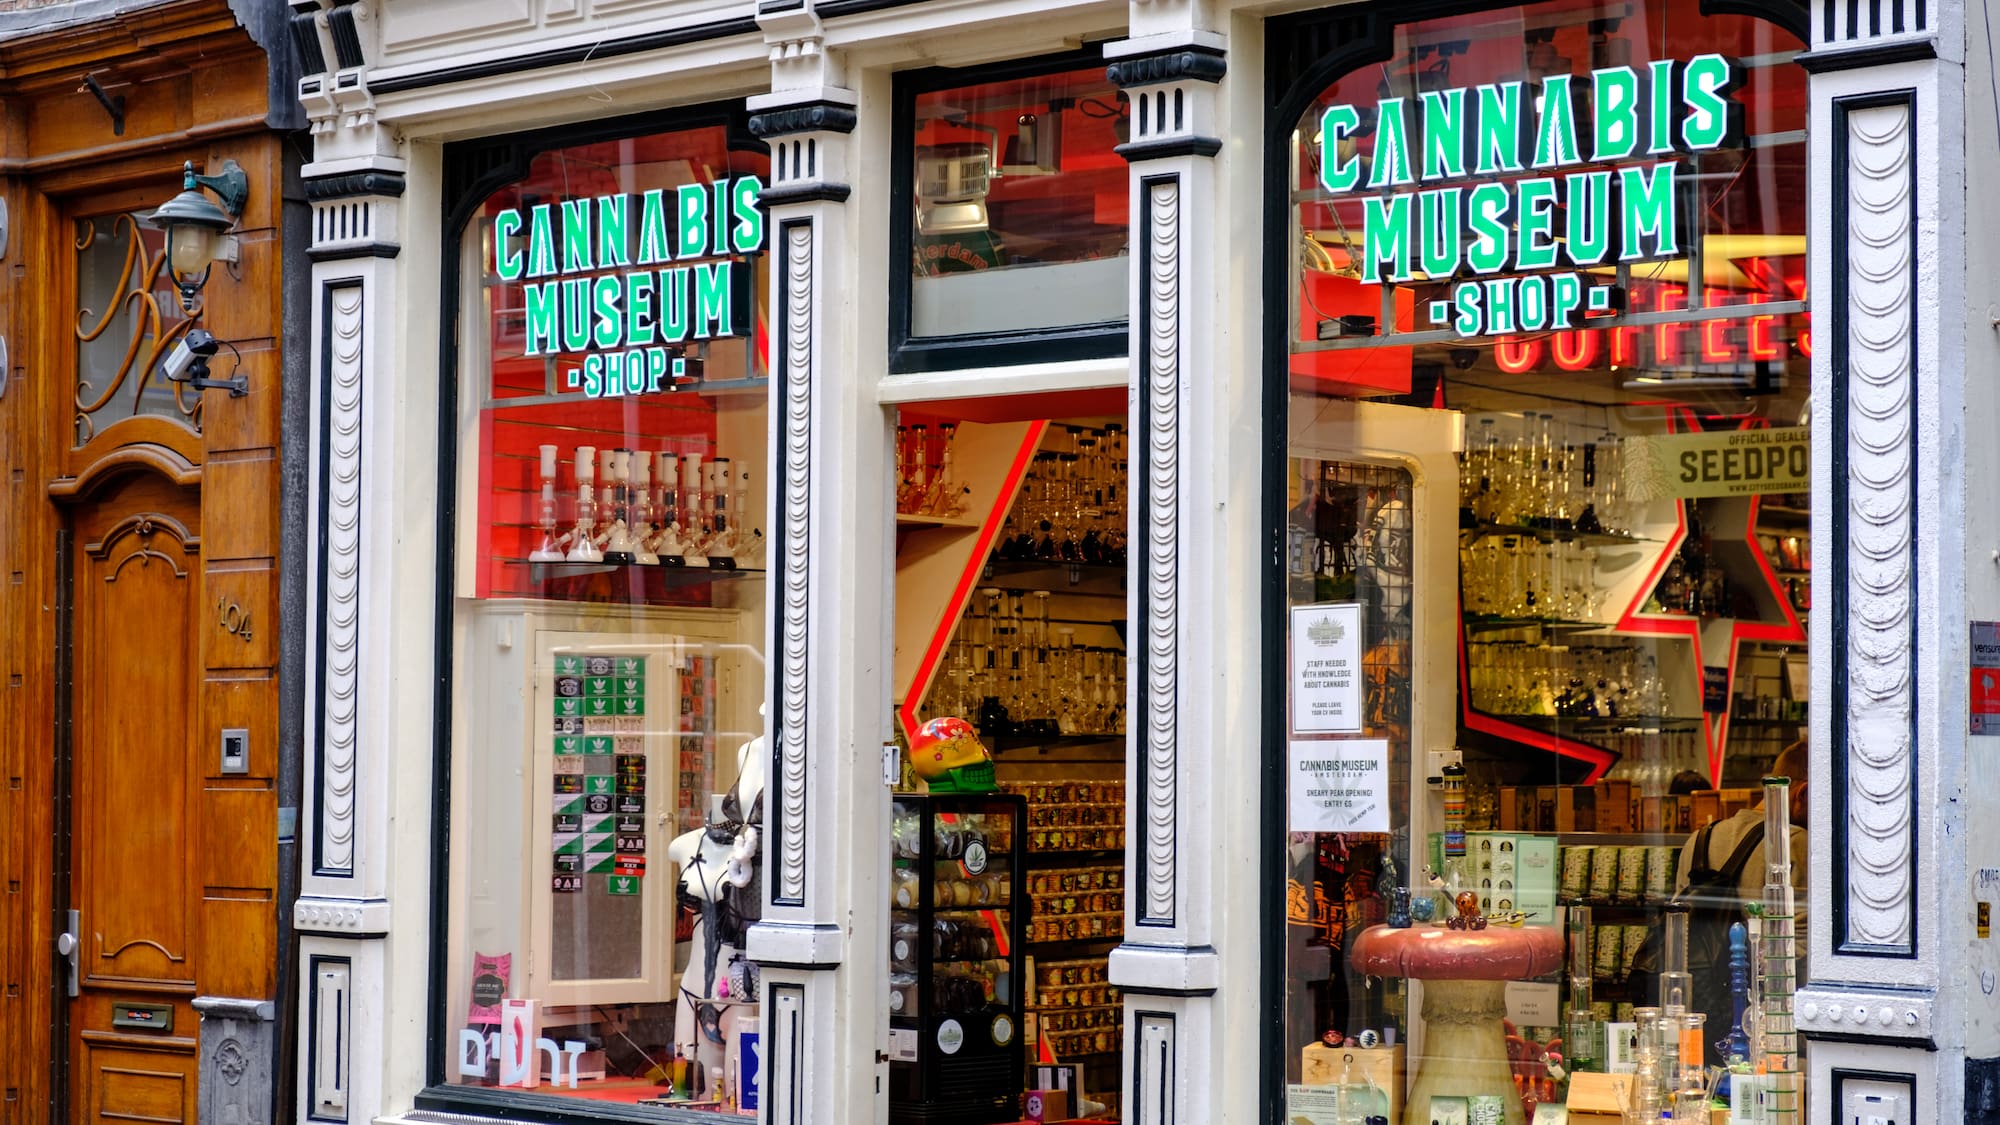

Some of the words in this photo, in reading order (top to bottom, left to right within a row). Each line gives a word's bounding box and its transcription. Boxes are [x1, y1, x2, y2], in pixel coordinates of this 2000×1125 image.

[1320, 53, 1730, 193] CANNABIS
[495, 175, 764, 281] CANNABIS
[1361, 161, 1679, 284] MUSEUM
[524, 261, 734, 356] MUSEUM
[1455, 272, 1582, 337] SHOP
[584, 346, 666, 399] SHOP
[1728, 433, 1772, 446] OFFICIAL
[1775, 431, 1811, 444] DEALE
[1680, 445, 1808, 483] SEEDPO
[217, 596, 253, 643] 104
[1318, 670, 1352, 678] KNOWLEDGE
[1325, 659, 1346, 667] NEEDED
[1304, 681, 1322, 689] ABOUT
[1323, 680, 1350, 688] CANNABIS
[1300, 760, 1340, 771] CANNABIS
[1341, 760, 1377, 771] MUSEUM
[1324, 800, 1343, 808] ENTRY
[1329, 789, 1345, 797] PEAK
